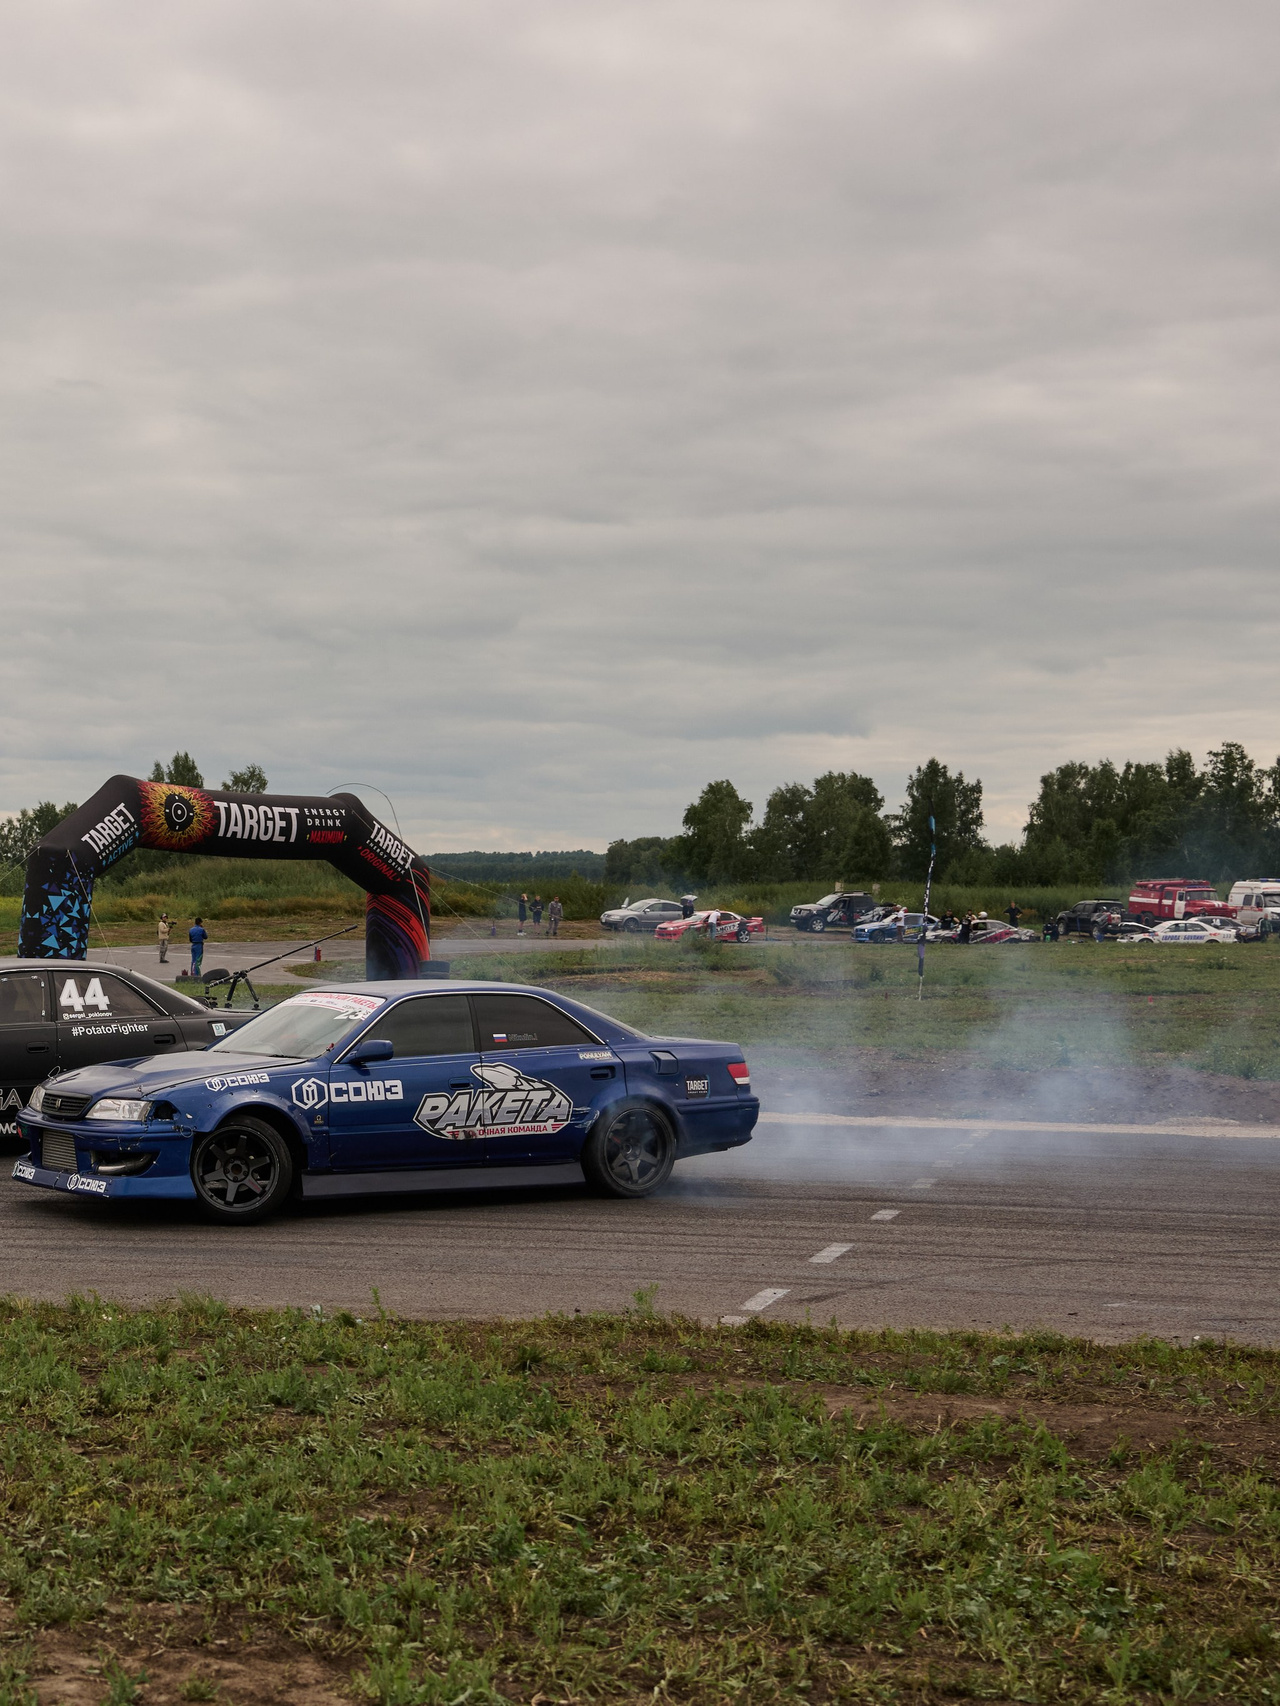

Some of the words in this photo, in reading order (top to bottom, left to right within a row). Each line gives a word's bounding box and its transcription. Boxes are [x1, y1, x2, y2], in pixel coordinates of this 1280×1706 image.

[304, 808, 347, 817] ENERGY
[80, 802, 135, 854] TARGET
[213, 801, 300, 843] TARGET
[307, 818, 342, 827] DRINK
[309, 830, 344, 844] MAXIMUM
[370, 820, 415, 870] TARGET
[107, 836, 134, 864] ACTIVE
[360, 848, 398, 881] ORIGINAL
[59, 977, 111, 1012] 44
[333, 1008, 363, 1020] 23
[71, 1023, 149, 1037] #PotatoFighter
[227, 1072, 271, 1087] СОЮЗ
[686, 1080, 709, 1091] TARGET
[328, 1080, 404, 1103] СОЮЗ
[418, 1088, 573, 1131] РАКЕТА
[507, 1124, 548, 1134] КОМАНДА
[78, 1177, 107, 1193] СОЮЗ
